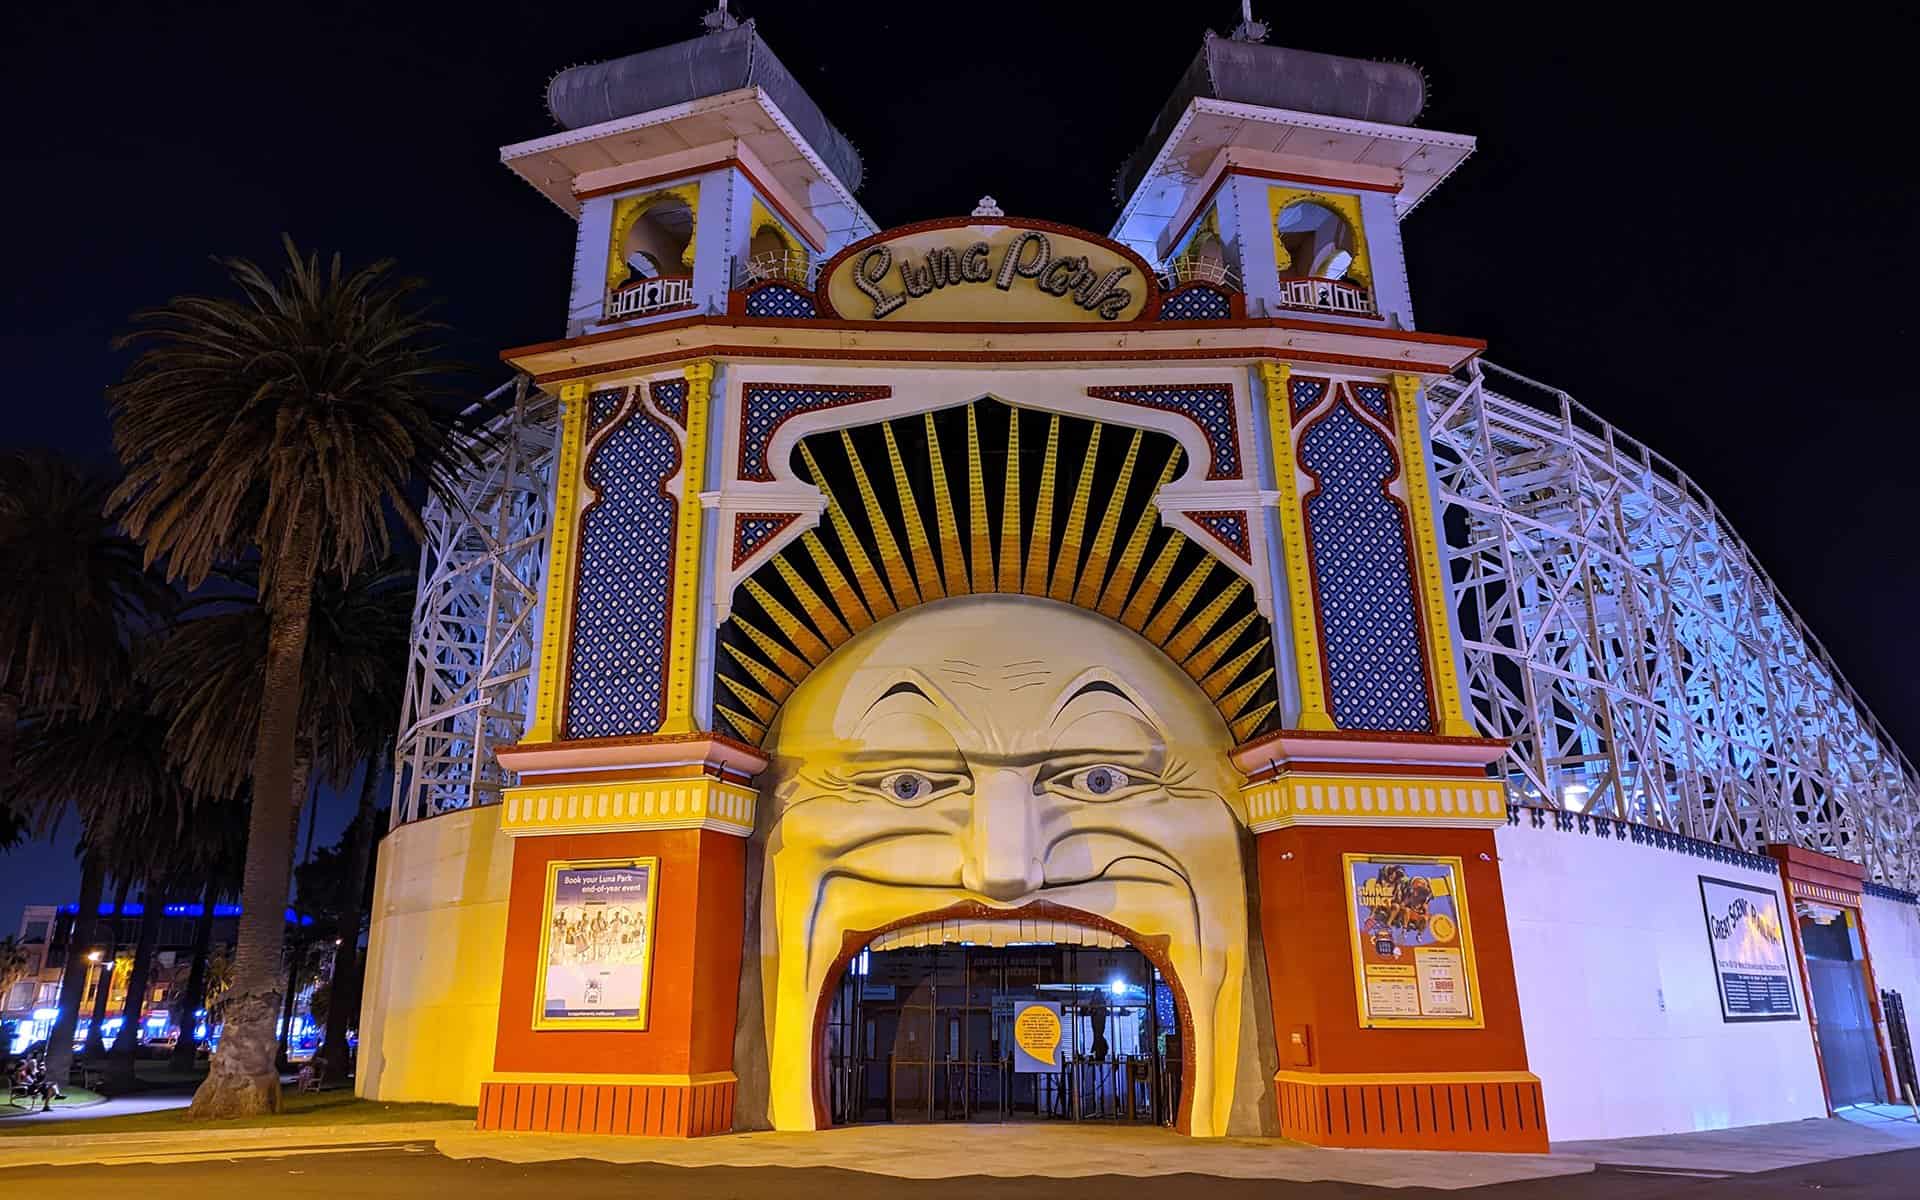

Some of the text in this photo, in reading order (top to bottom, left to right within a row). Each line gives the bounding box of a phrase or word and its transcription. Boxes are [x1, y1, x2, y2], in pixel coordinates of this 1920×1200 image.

[854, 231, 1131, 320] Luna Park
[564, 876, 581, 884] Book
[599, 875, 616, 883] Luna
[617, 874, 632, 882] Park
